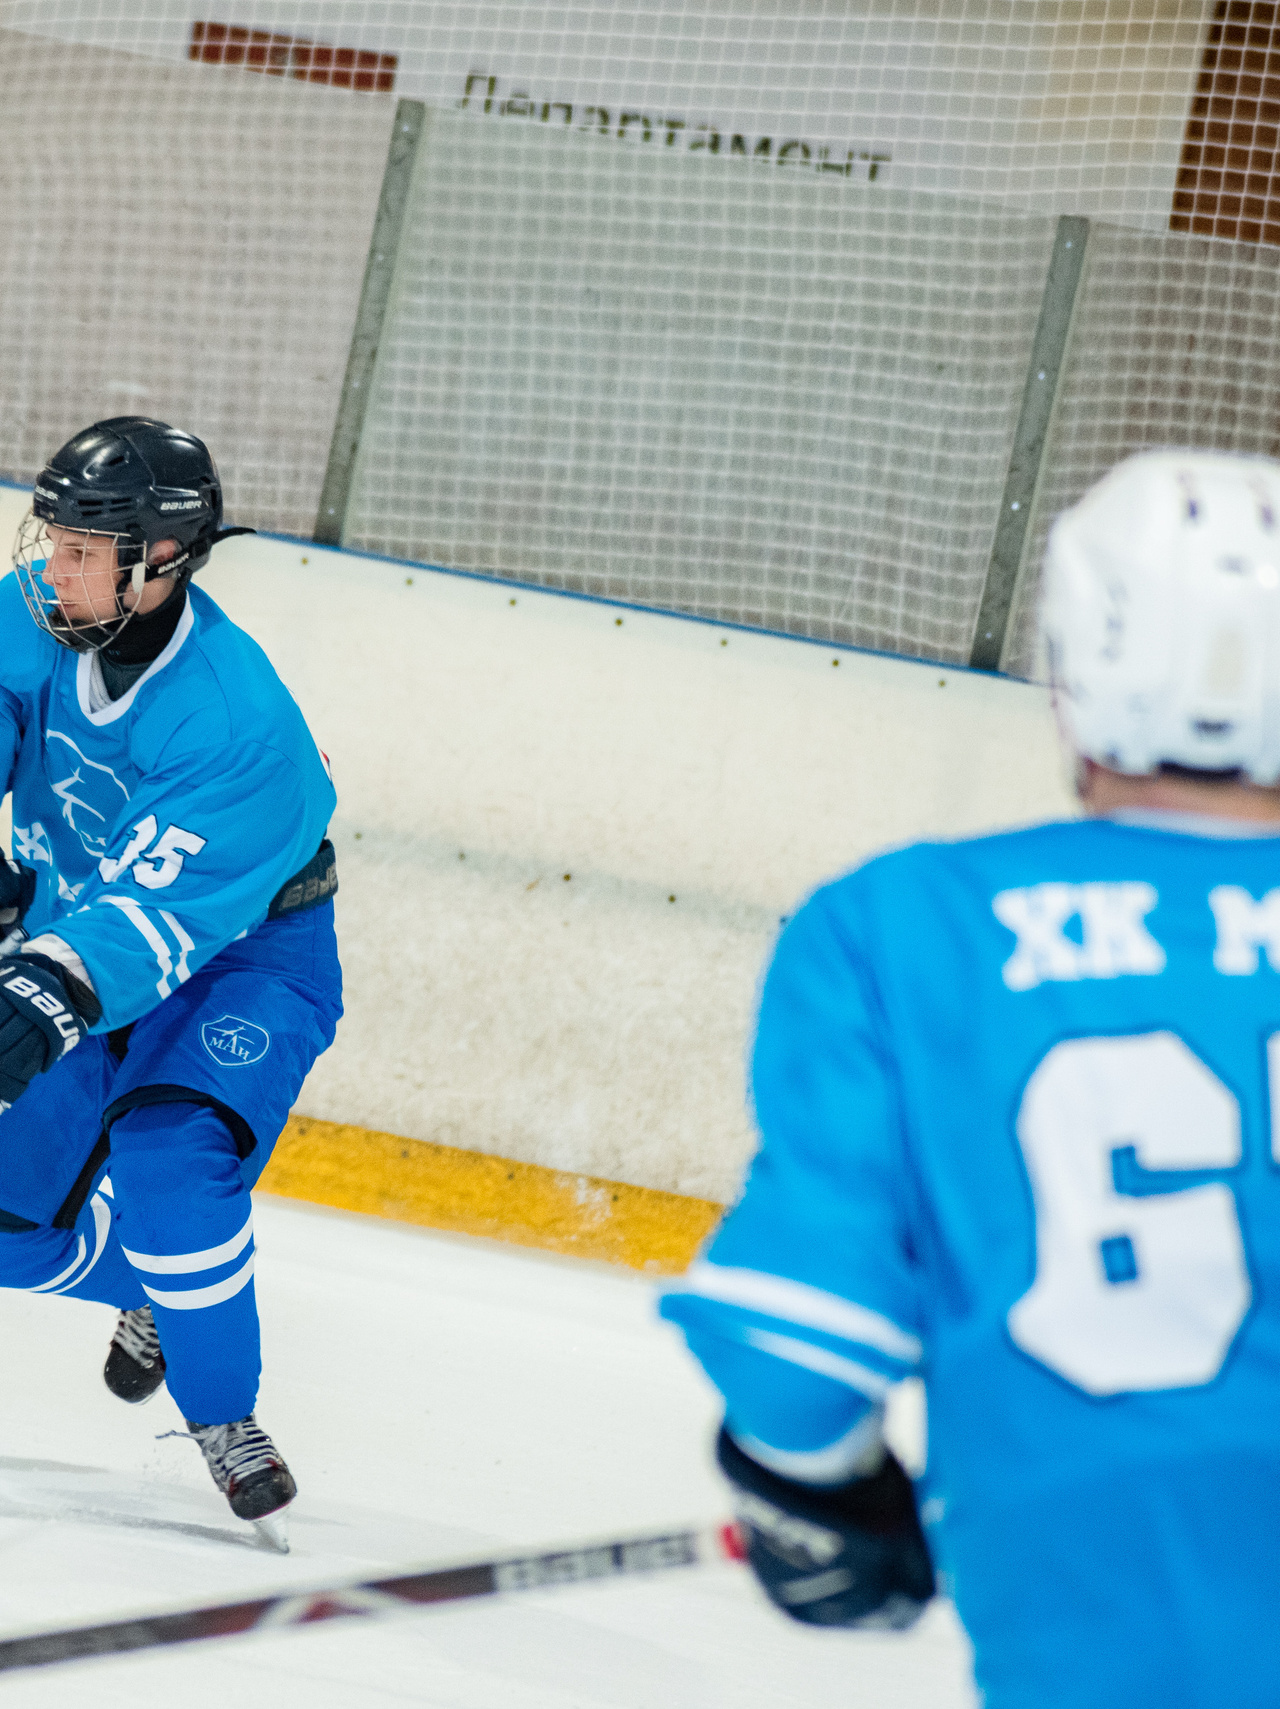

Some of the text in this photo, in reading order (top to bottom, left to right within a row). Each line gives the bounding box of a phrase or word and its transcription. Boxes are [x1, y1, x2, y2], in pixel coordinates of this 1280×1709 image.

[160, 499, 203, 511] BAUER
[3, 976, 81, 1062] BAU
[1006, 1027, 1280, 1397] 6
